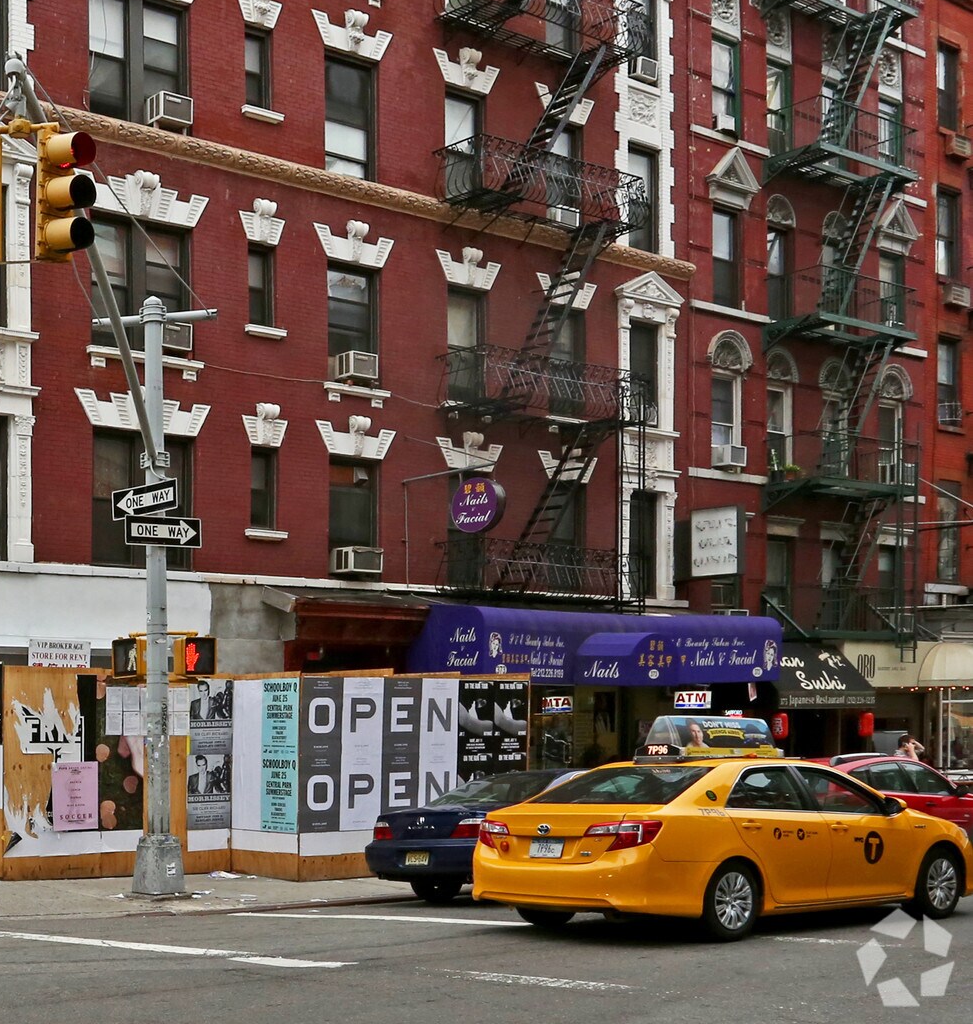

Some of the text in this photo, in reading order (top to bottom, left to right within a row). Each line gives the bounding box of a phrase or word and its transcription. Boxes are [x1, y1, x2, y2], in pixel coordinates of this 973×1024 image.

[126, 489, 170, 508] ONE WAY
[459, 493, 488, 506] Nails
[456, 510, 491, 524] Facial
[137, 525, 189, 538] ONE WAY
[450, 627, 477, 643] Nails
[49, 642, 84, 650] BROKERAGE
[684, 638, 710, 650] Beauty
[712, 638, 729, 647] Salon
[32, 652, 87, 661] STORE FOR RENT
[447, 651, 479, 667] Facial
[690, 651, 715, 667] Nails
[728, 650, 757, 665] Facial
[583, 660, 619, 679] Nails
[857, 654, 875, 679] ORO
[795, 670, 846, 691] Sushi
[263, 682, 297, 693] SCHOOLBOY Q
[272, 694, 282, 702] JUNE
[675, 692, 707, 703] ATM
[789, 695, 815, 707] Japanese
[815, 695, 845, 704] Restaurant
[308, 697, 452, 734] OPEN
[702, 720, 741, 729] DON'T MISS
[647, 745, 668, 755] 7P96
[262, 759, 297, 770] SCHOOLBOY Q
[271, 771, 287, 779] JUNE 25
[306, 771, 450, 811] OPEN
[698, 808, 725, 816] 7P96
[868, 837, 880, 860] T
